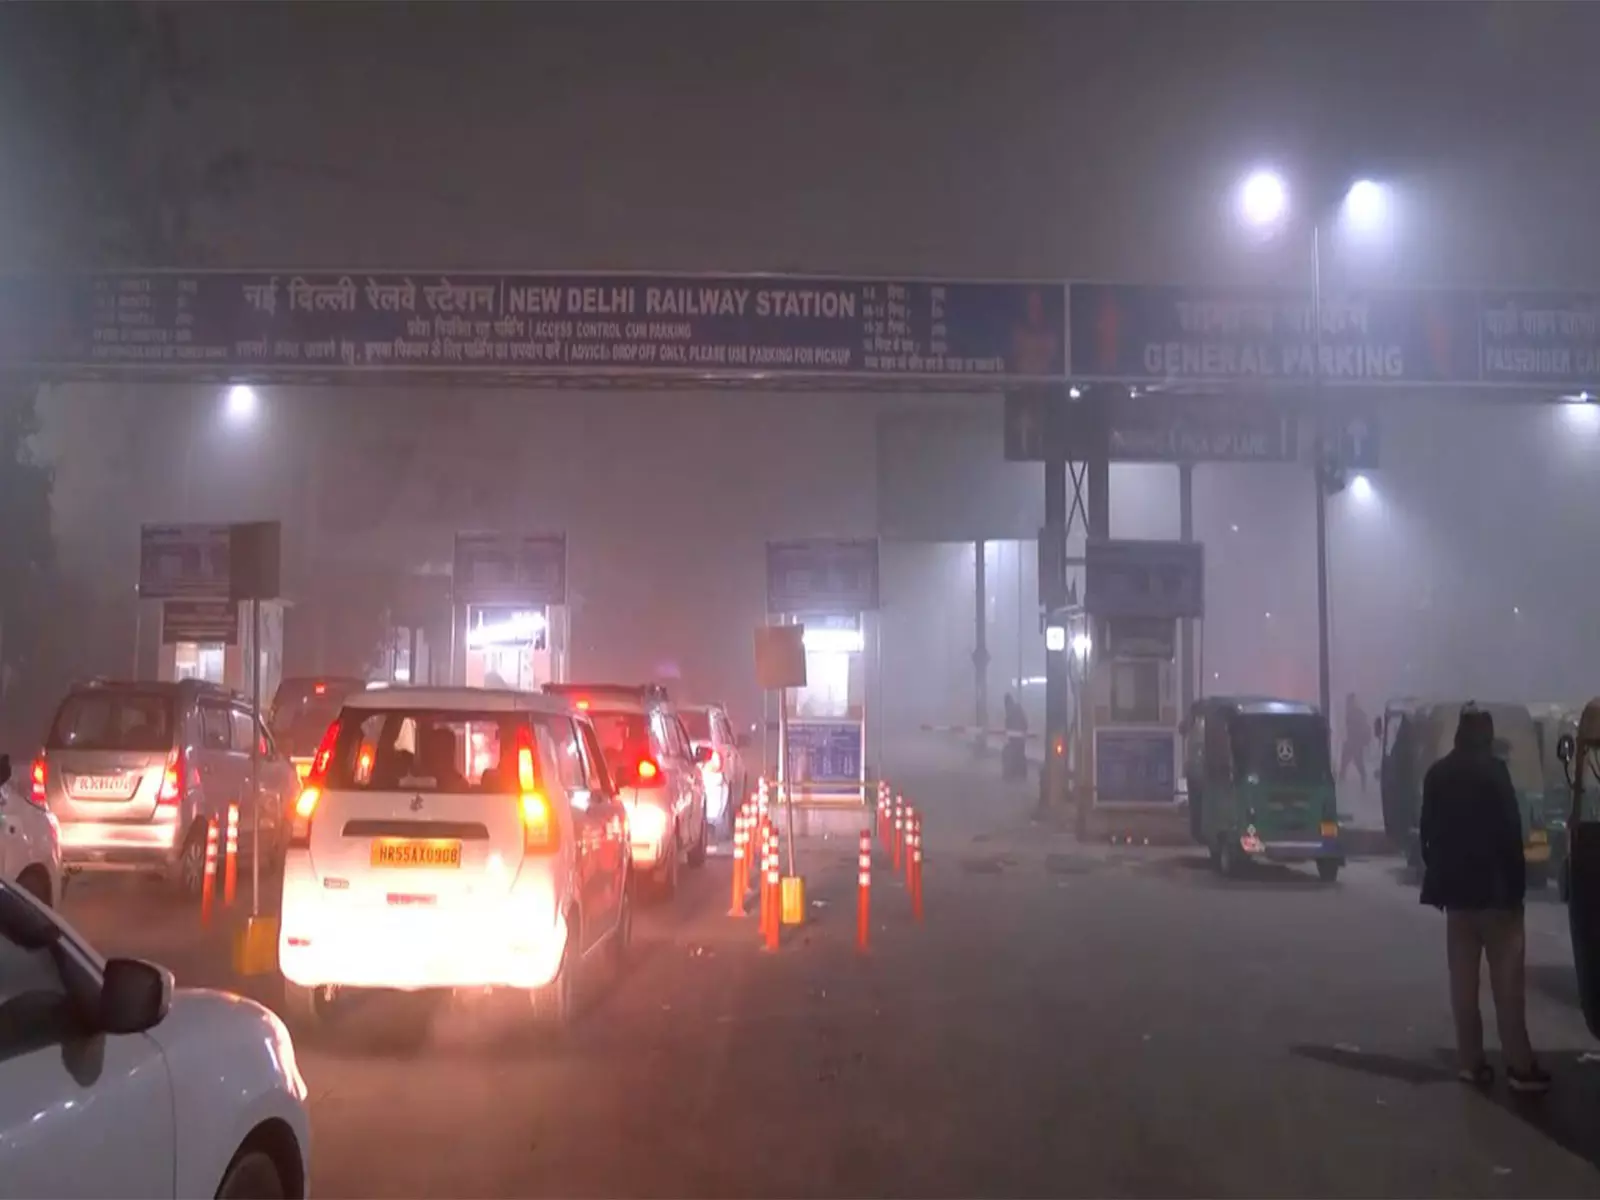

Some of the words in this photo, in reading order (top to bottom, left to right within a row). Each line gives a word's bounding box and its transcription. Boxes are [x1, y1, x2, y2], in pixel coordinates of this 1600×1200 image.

[242, 277, 279, 317] नई
[286, 277, 357, 313] दिल्ली
[364, 277, 416, 312] रेलवे
[422, 278, 495, 312] स्टेशन
[509, 286, 562, 314] NEW
[567, 287, 634, 314] DELHI
[645, 287, 749, 317] RAILWAY
[756, 290, 856, 319] STATION
[535, 320, 573, 338] ACCESS
[576, 321, 622, 338] CONTROL
[649, 321, 691, 340] PARKING
[612, 343, 637, 361] DROP
[1143, 343, 1274, 375] GENERAL
[1282, 345, 1404, 377] PARKING
